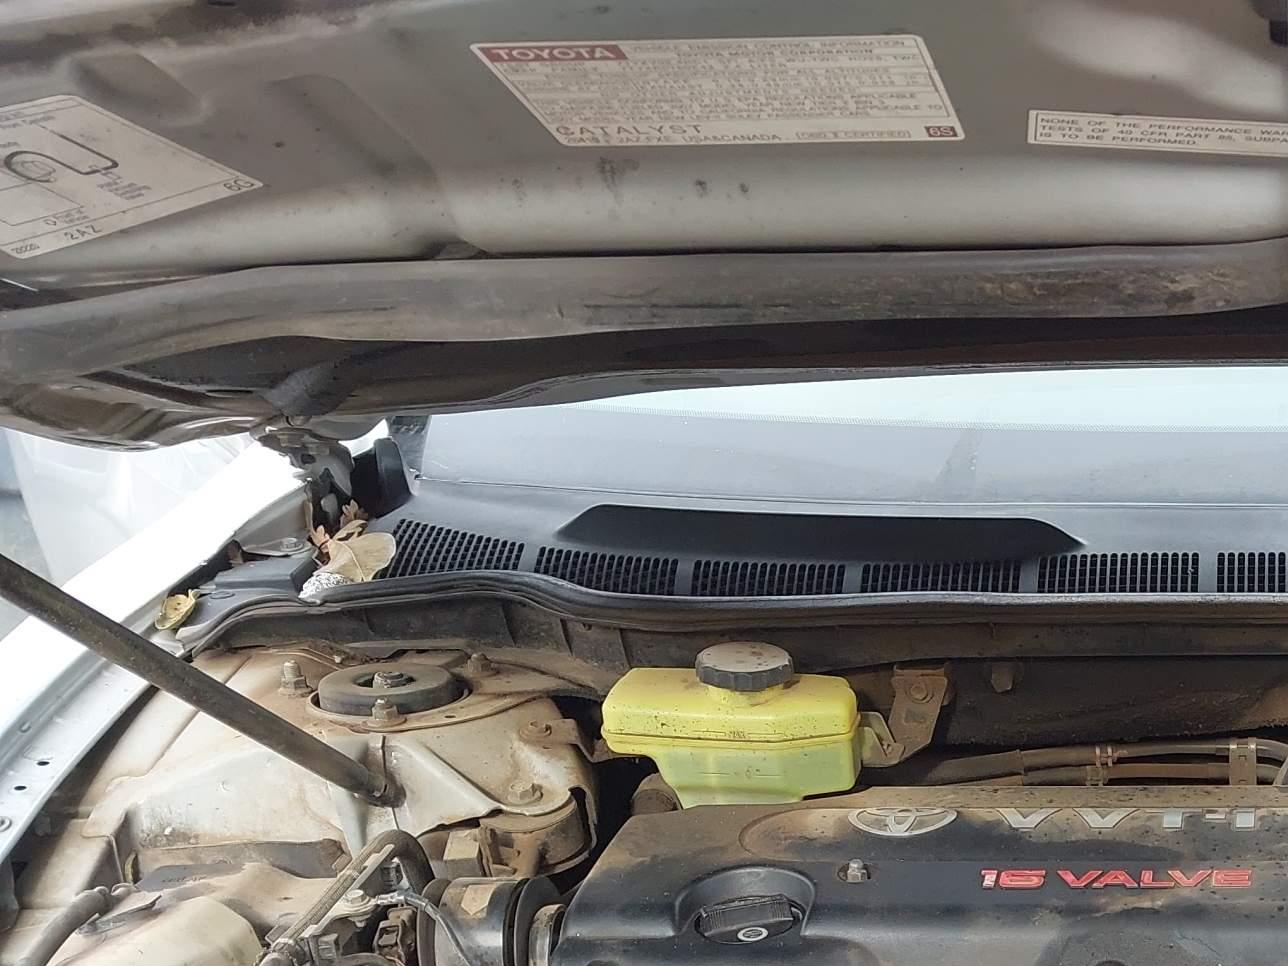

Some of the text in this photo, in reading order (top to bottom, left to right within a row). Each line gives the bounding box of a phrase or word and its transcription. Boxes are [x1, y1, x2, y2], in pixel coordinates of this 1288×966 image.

[491, 46, 617, 60] TOYOTA
[556, 124, 701, 136] CATALYST
[928, 126, 954, 137] 6S
[1040, 117, 1079, 125] NONE
[1087, 119, 1106, 127] OF
[1149, 123, 1252, 135] PERFORMANCE
[1040, 125, 1083, 133] TESTS
[1141, 129, 1167, 137] CFR
[1176, 131, 1210, 139] PART
[64, 224, 103, 240] 2AZ
[980, 869, 1253, 889] 16 VALVE
